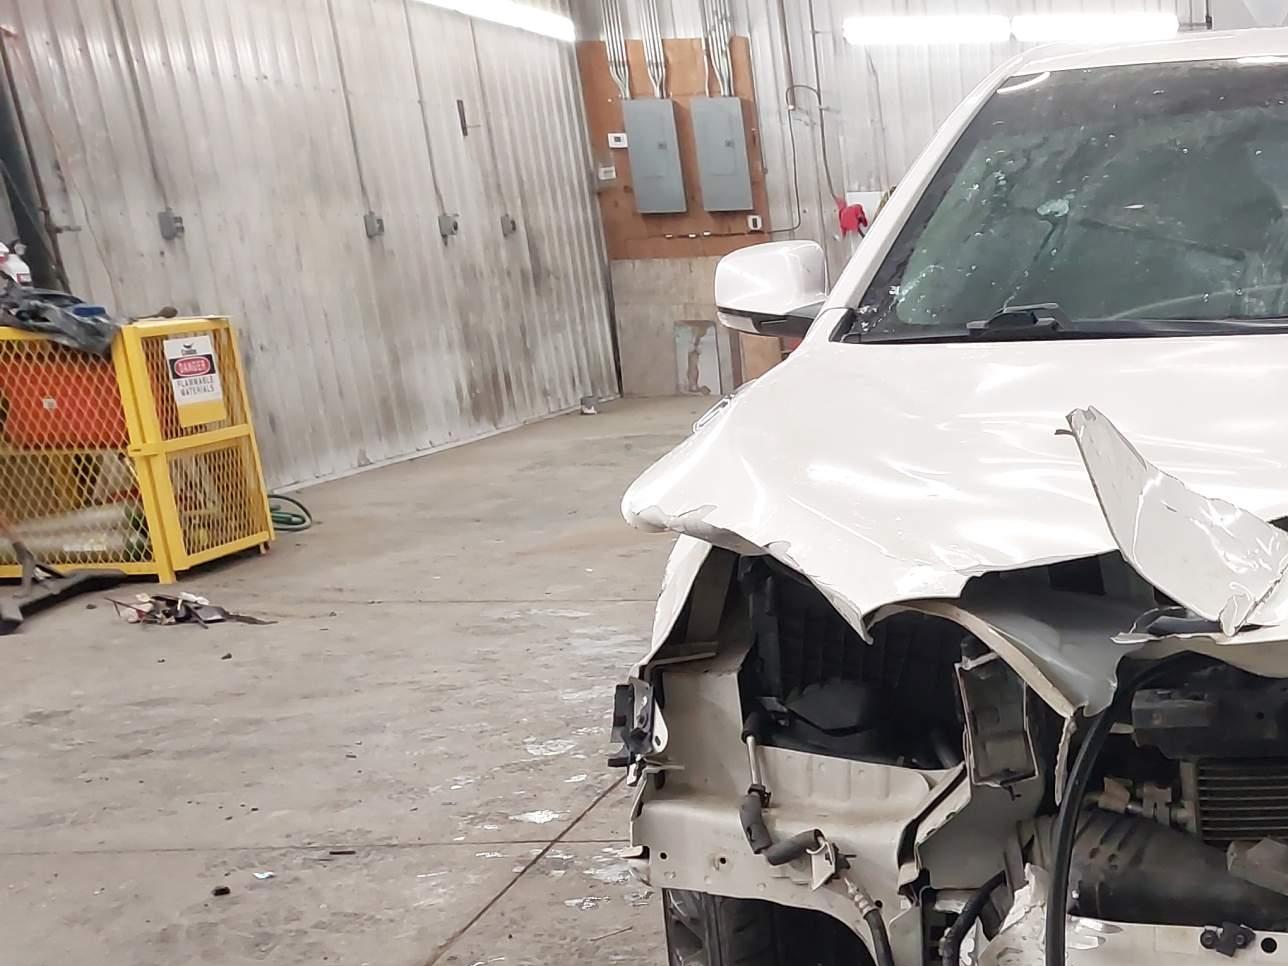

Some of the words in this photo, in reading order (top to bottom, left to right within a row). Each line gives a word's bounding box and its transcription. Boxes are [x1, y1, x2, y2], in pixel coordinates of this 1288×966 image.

[178, 359, 205, 373] DANGER
[176, 376, 213, 387] FLAMMABLE
[180, 384, 215, 396] MATERIALS
